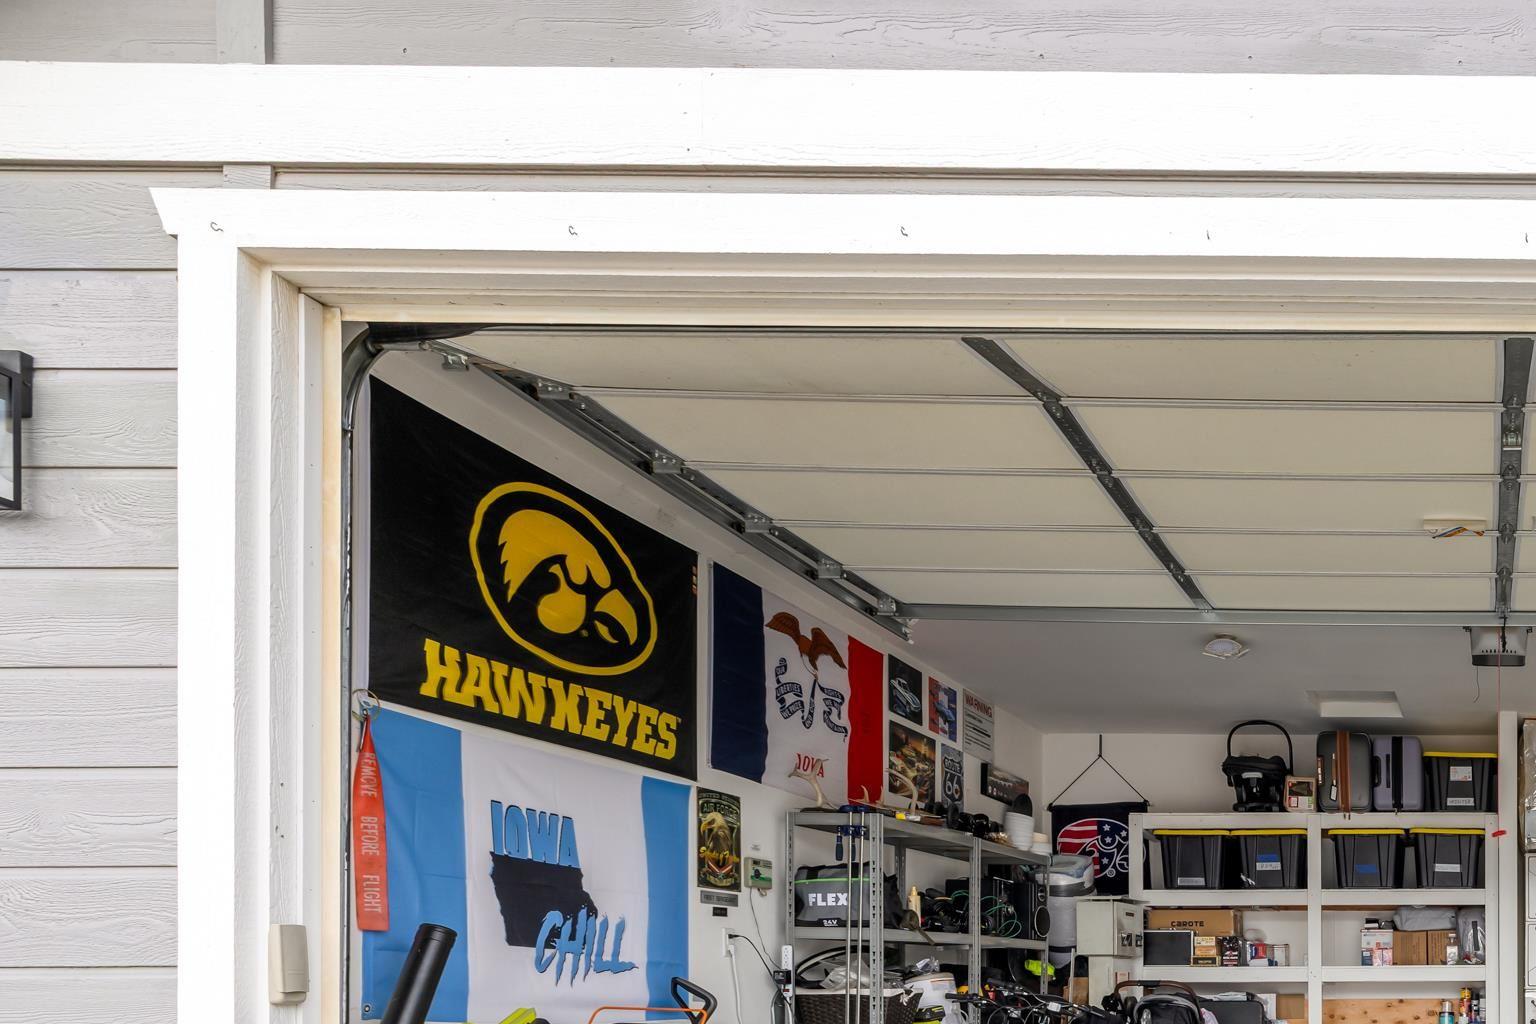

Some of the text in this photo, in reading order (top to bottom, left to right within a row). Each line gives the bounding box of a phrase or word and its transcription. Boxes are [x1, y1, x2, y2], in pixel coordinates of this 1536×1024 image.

[419, 637, 678, 761] HAWKEYES
[359, 751, 377, 798] REMOVE
[944, 757, 962, 775] ROUTE
[702, 802, 716, 813] AIR
[361, 815, 379, 856] BEFORE
[489, 799, 581, 869] IOWA
[362, 873, 382, 914] FLIGHT
[807, 892, 849, 907] FLEX
[822, 918, 840, 928] 24V
[534, 905, 640, 988] CHILL
